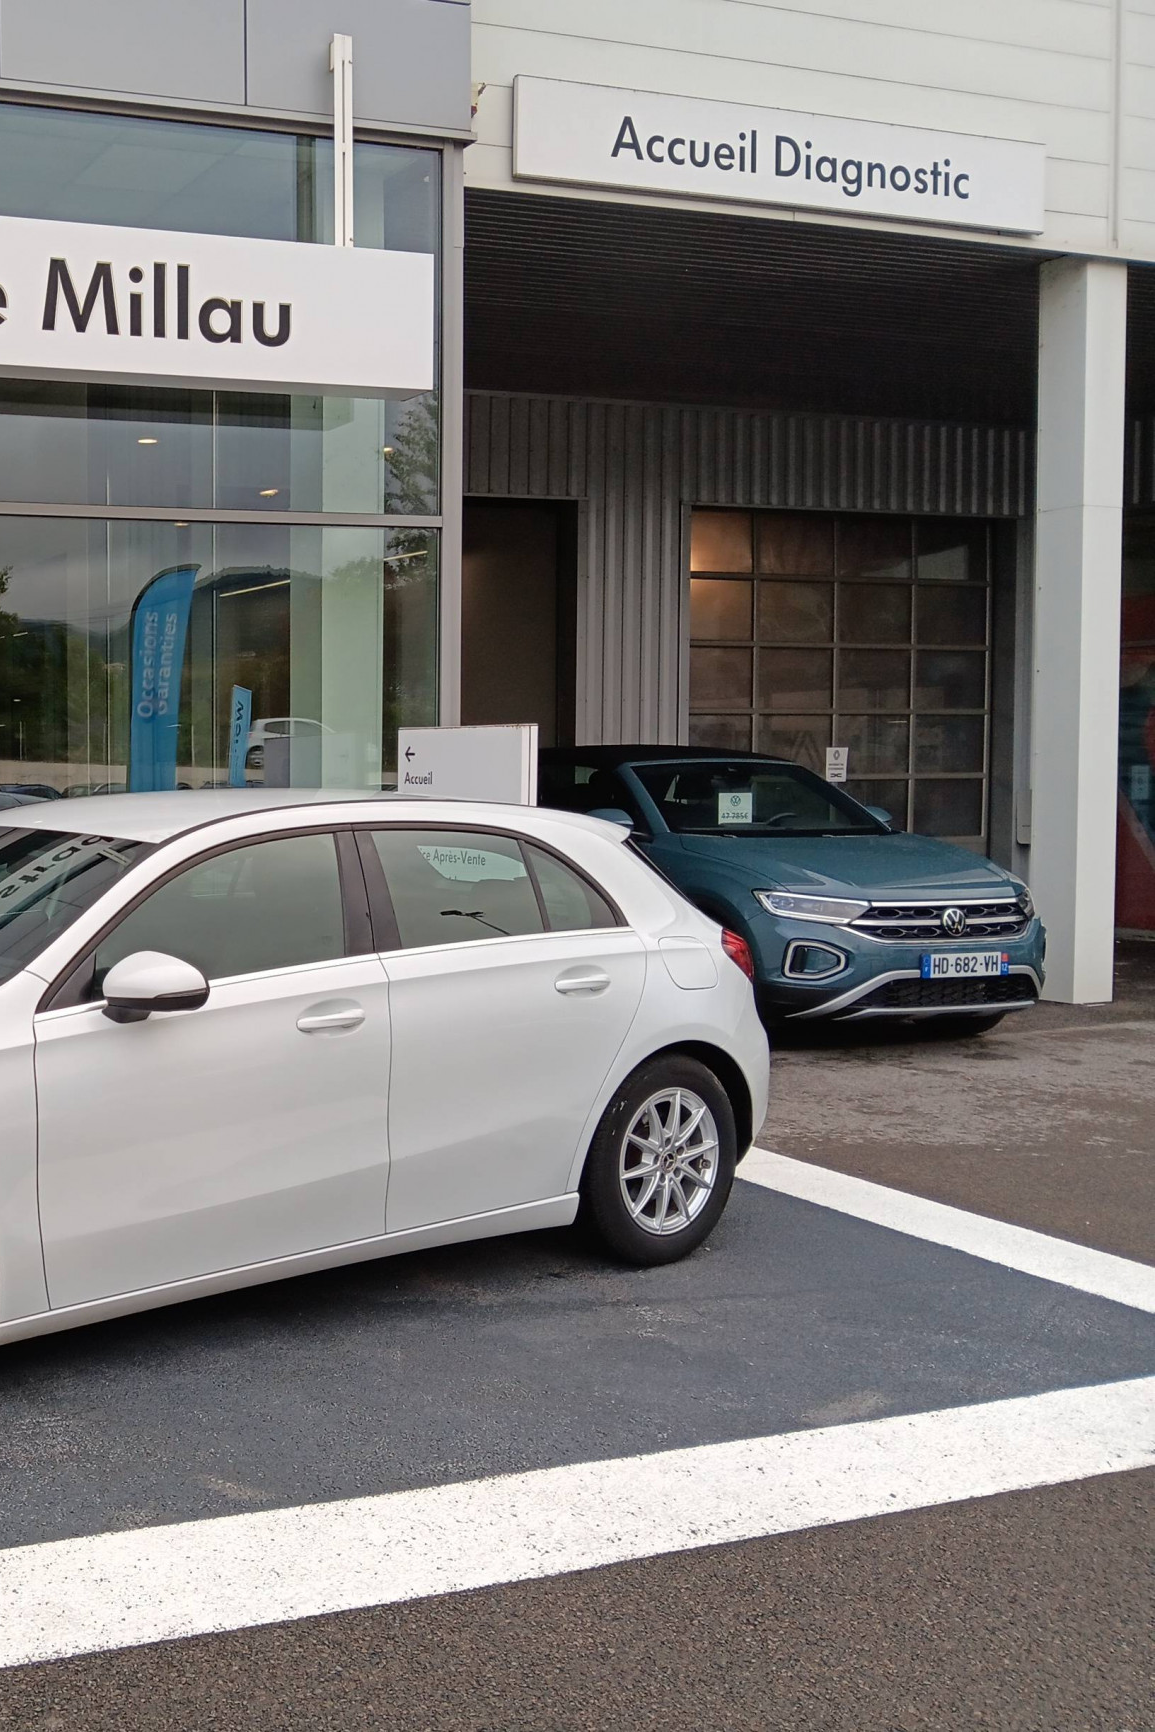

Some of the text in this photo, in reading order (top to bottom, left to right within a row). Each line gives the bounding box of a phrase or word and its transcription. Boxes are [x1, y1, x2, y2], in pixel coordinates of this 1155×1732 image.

[611, 115, 970, 200] Accueil Diagnostic
[42, 257, 292, 348] Millau
[137, 611, 158, 718] Occasions
[404, 771, 433, 785] Accueil
[433, 848, 486, 867] Après-Vente
[933, 955, 999, 975] HD-682-VH
